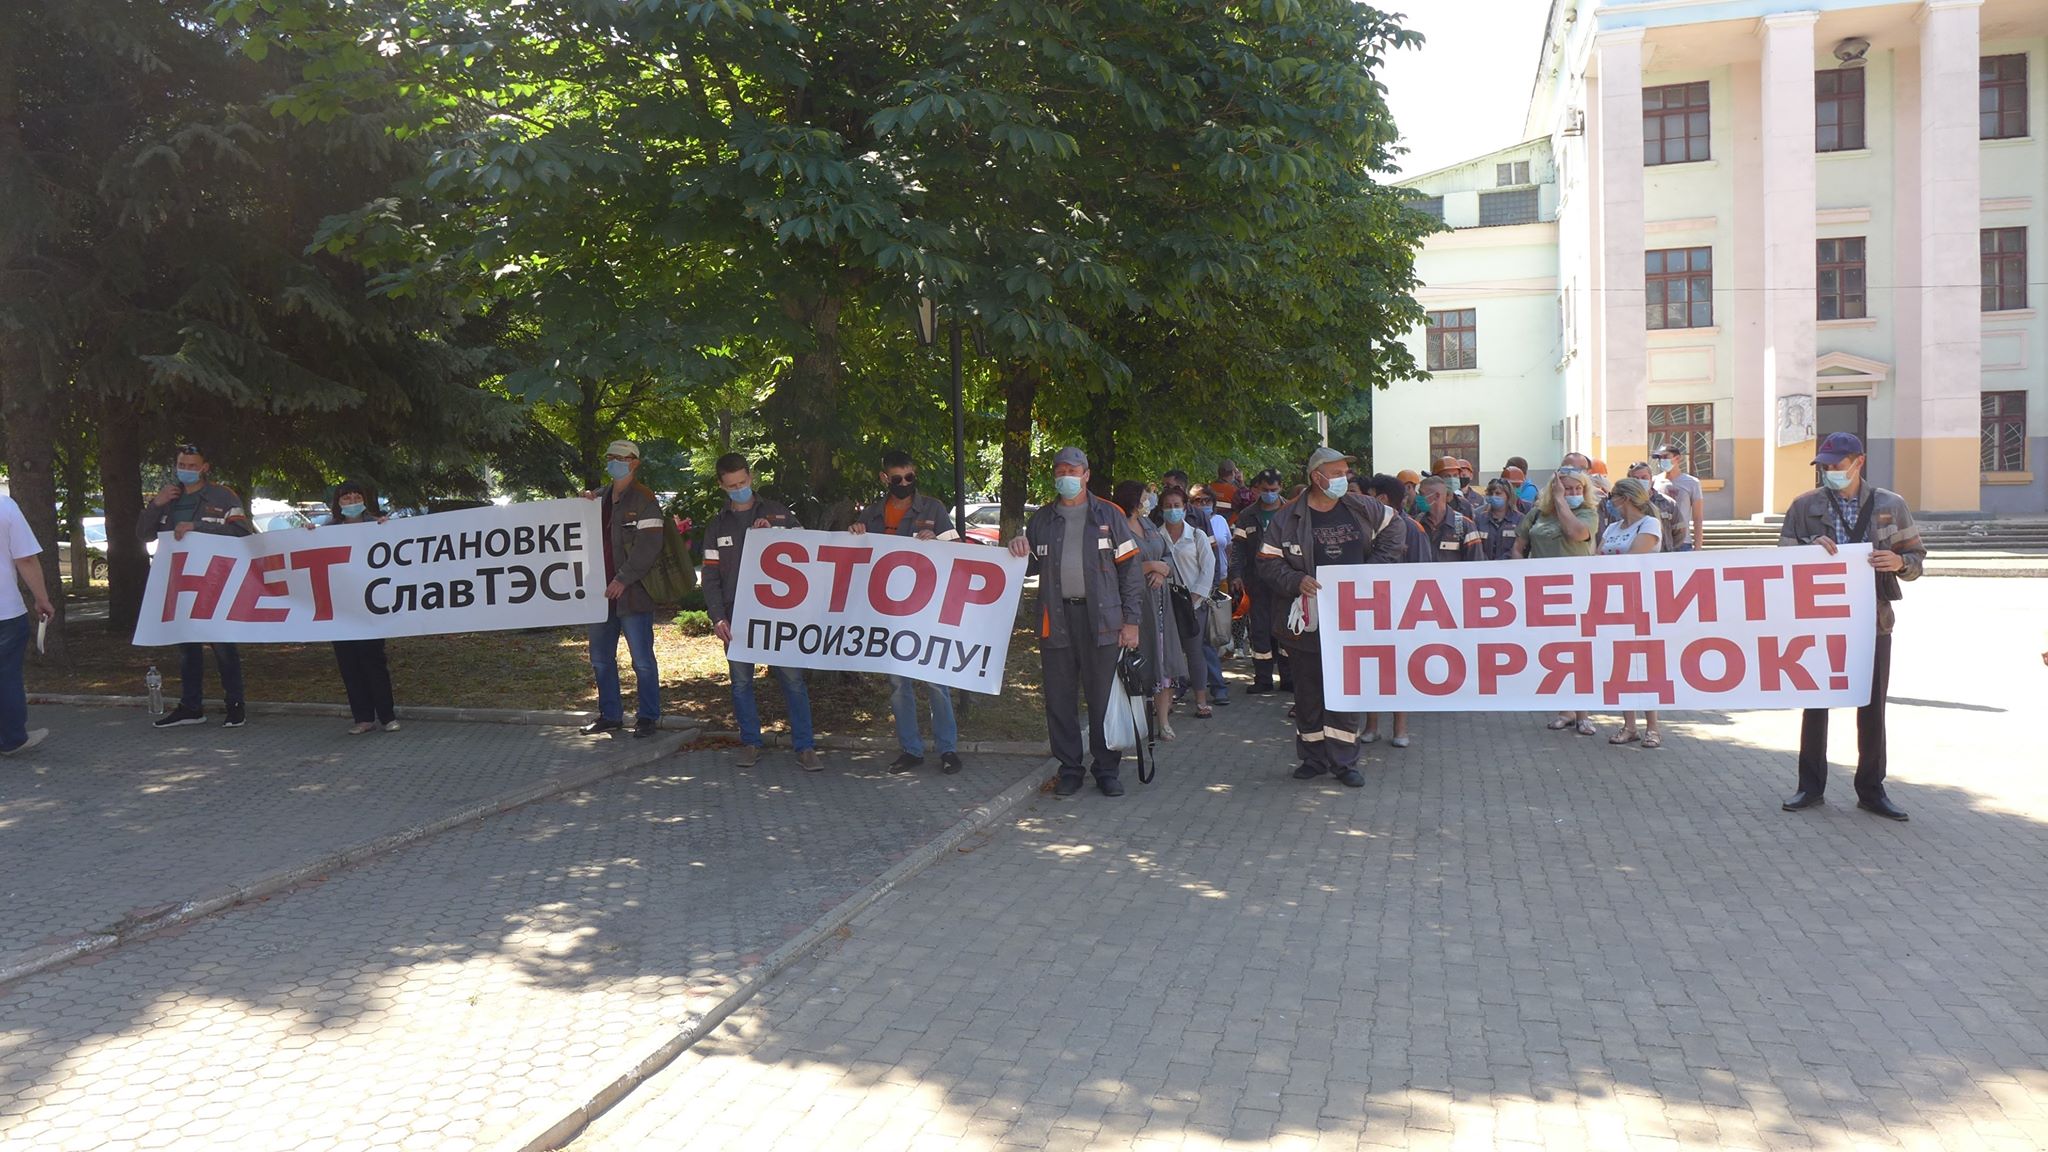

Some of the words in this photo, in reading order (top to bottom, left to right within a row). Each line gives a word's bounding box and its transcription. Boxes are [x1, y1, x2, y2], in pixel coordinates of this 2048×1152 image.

[367, 521, 583, 569] ОСТАНОВКЕ
[161, 545, 353, 622] НЕТ
[364, 562, 586, 615] СлавТЭС!
[754, 541, 1006, 625] STOP
[1338, 562, 1851, 637] НАВЕДИТЕ
[747, 618, 992, 678] ПРОИЗВОЛУ!
[1343, 634, 1849, 705] ПОРЯДОК!
